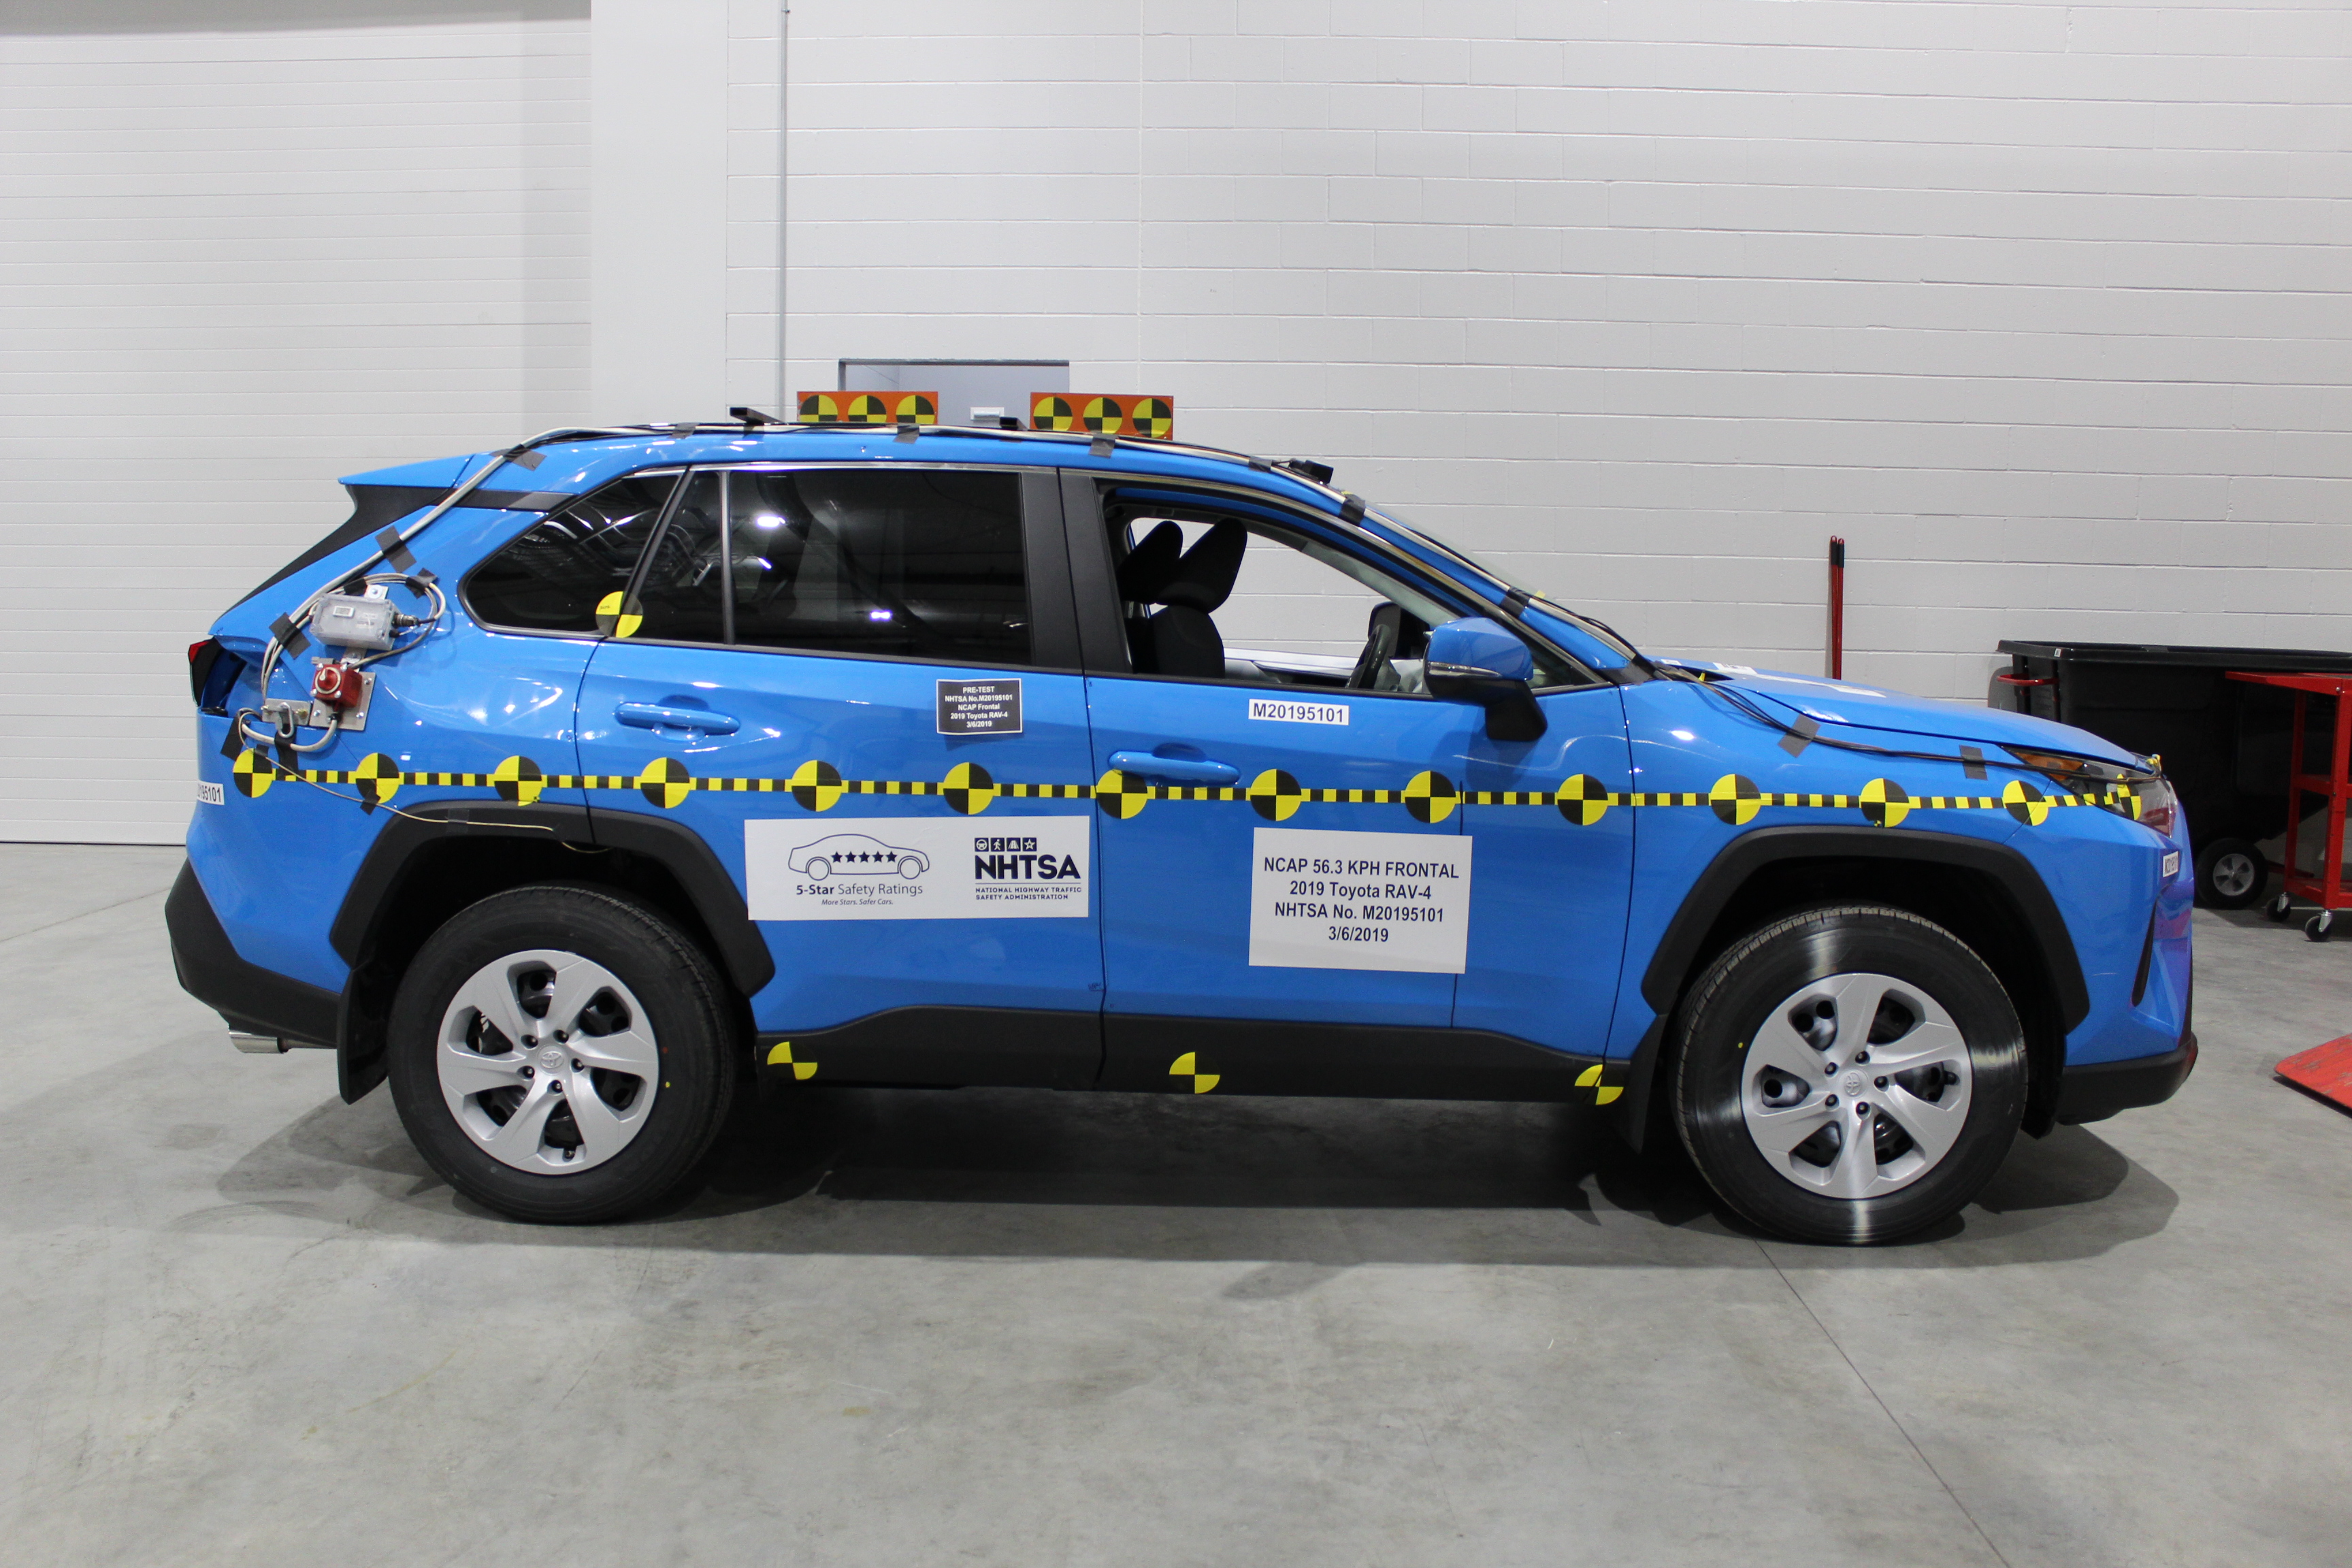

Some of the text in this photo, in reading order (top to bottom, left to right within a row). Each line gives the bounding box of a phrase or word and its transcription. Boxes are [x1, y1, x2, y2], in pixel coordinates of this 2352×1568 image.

[966, 712, 987, 720] Toyota
[1253, 702, 1343, 723] M20195101
[975, 854, 1081, 880] NHTSA
[1264, 857, 1459, 879] NCAP 56.3 KPH FRONTAL
[796, 883, 924, 897] 5-Star Safety Ratings
[1290, 881, 1431, 900] 2019 Toyota RAV-4
[1275, 902, 1443, 922] NHTSA No. M20195101
[1328, 926, 1388, 942] 3/6/2019
